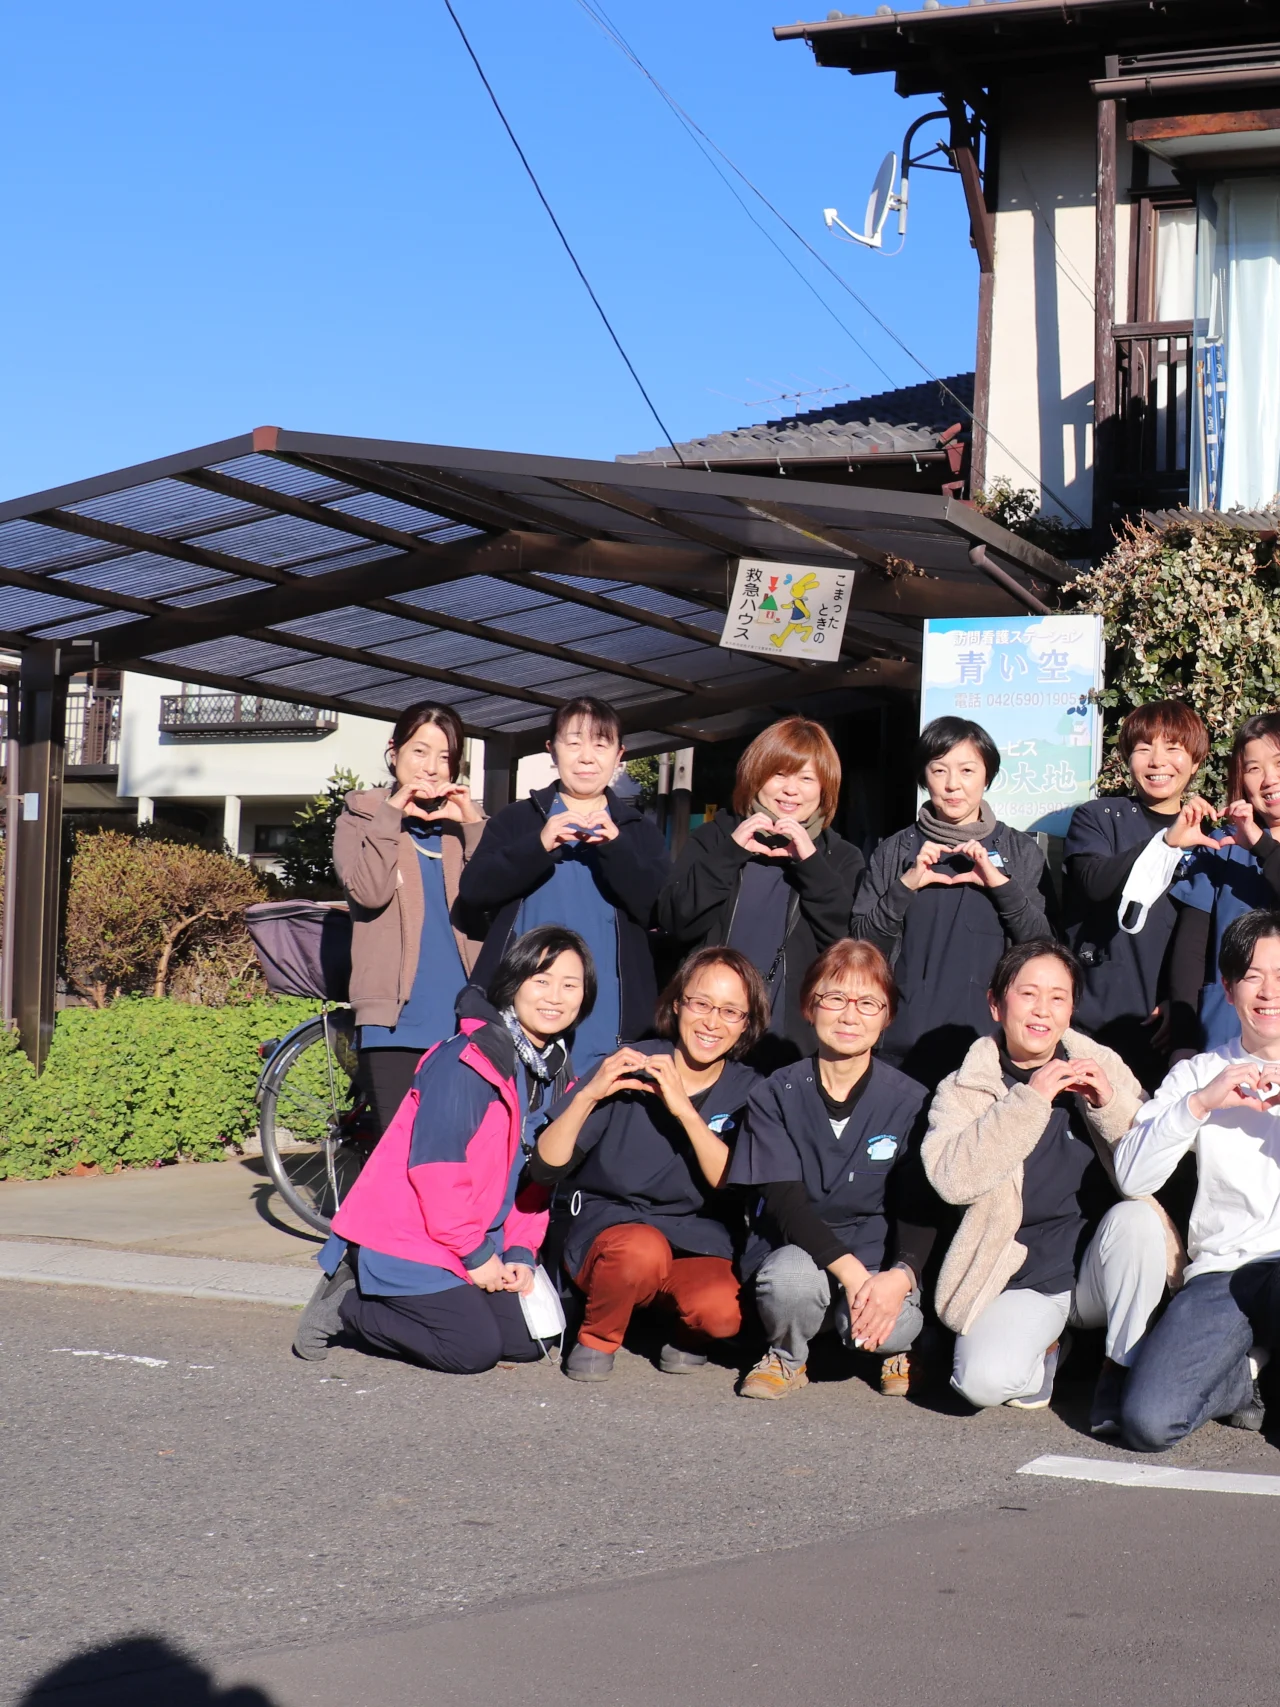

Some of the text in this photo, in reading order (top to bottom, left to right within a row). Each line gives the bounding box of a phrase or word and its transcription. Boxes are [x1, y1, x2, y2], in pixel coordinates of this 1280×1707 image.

[733, 567, 763, 640] 救急ハウス
[827, 574, 847, 630] こまった
[813, 603, 829, 644] ときの
[953, 629, 1084, 647] 訪問看護ステーション
[955, 648, 1071, 684] 青い空
[954, 691, 1077, 709] 電話 042(590)1905
